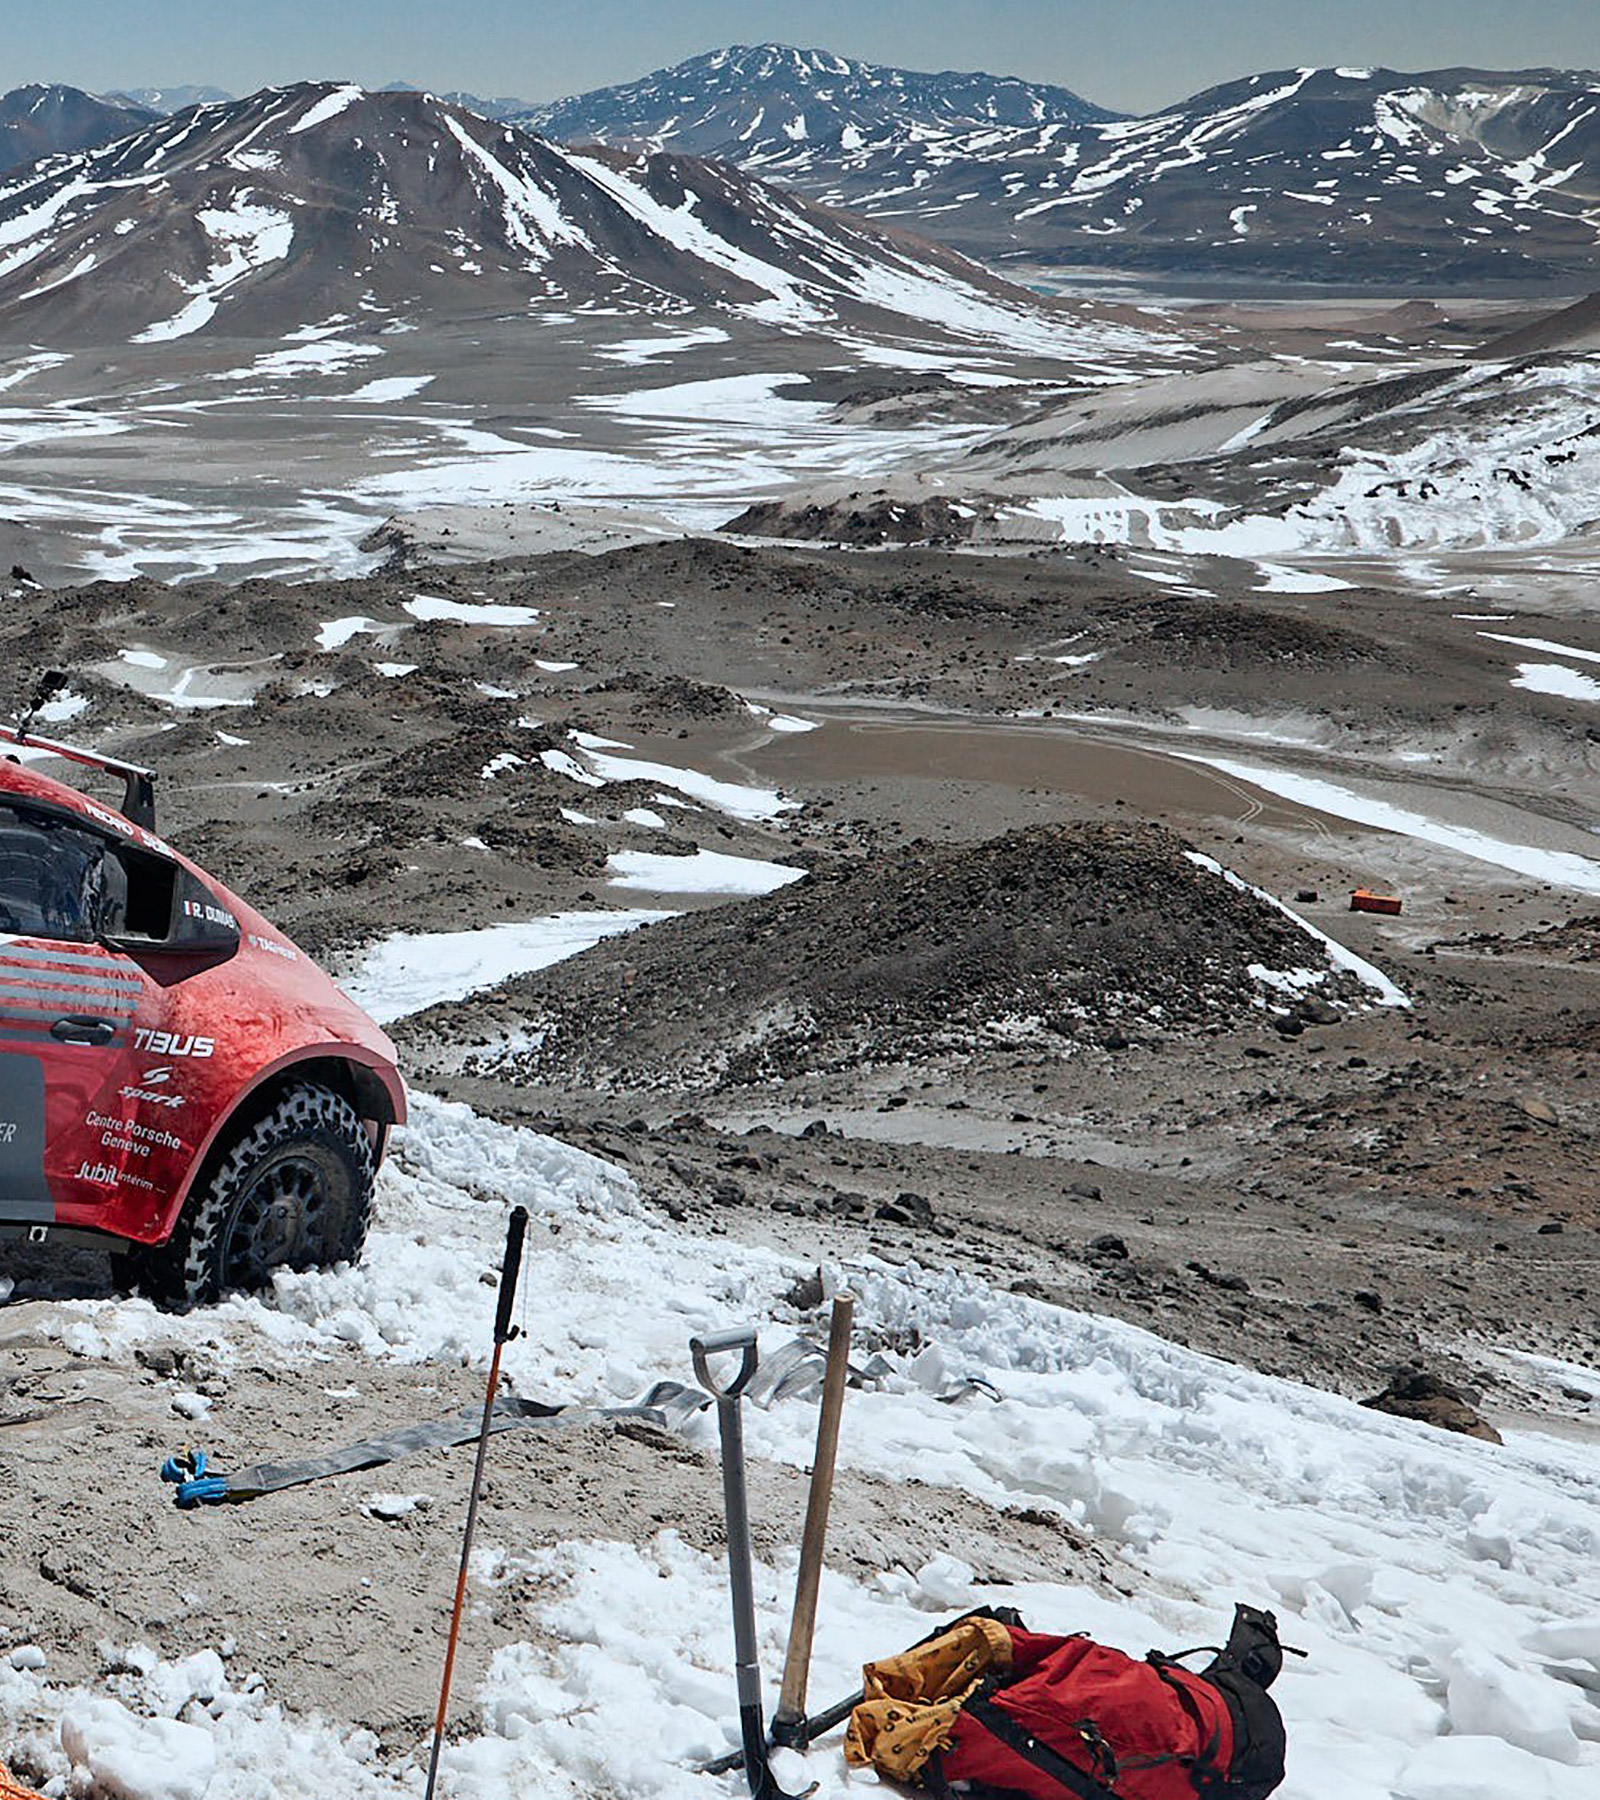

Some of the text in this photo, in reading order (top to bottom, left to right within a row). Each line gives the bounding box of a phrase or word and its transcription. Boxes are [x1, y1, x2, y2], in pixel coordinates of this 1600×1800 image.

[86, 1110, 181, 1150] Centre Porsche
[101, 1131, 150, 1157] Genève
